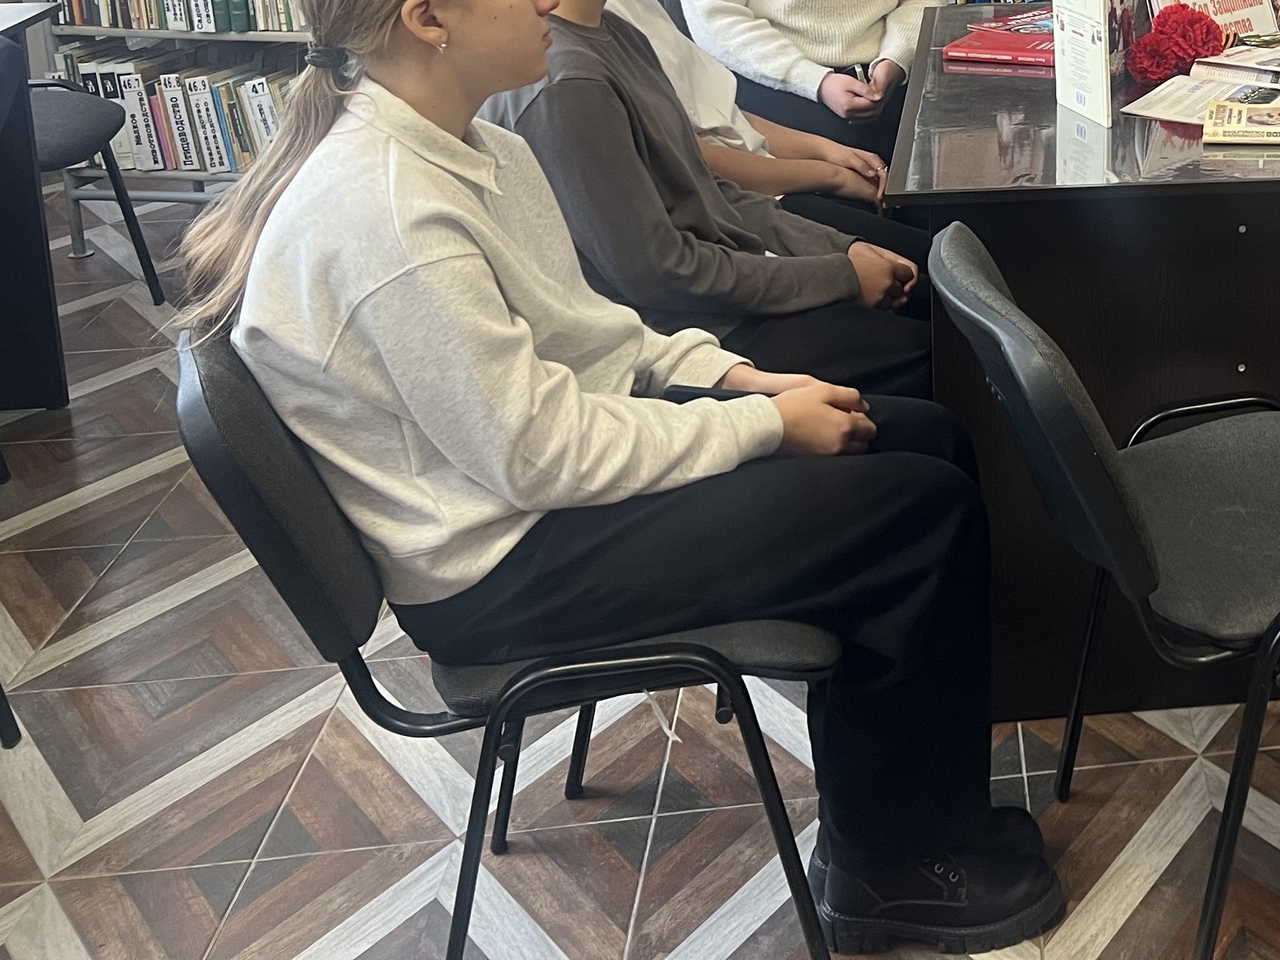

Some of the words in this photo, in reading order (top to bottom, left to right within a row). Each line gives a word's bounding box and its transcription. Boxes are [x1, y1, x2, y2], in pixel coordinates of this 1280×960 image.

[122, 74, 141, 89] 46.7
[188, 78, 208, 93] 46.9
[250, 82, 265, 93] 47
[129, 113, 143, 146] Мелкое
[136, 91, 159, 165] животноводство
[169, 96, 194, 166] Птицеводство
[194, 98, 216, 168] Пчеловодство.
